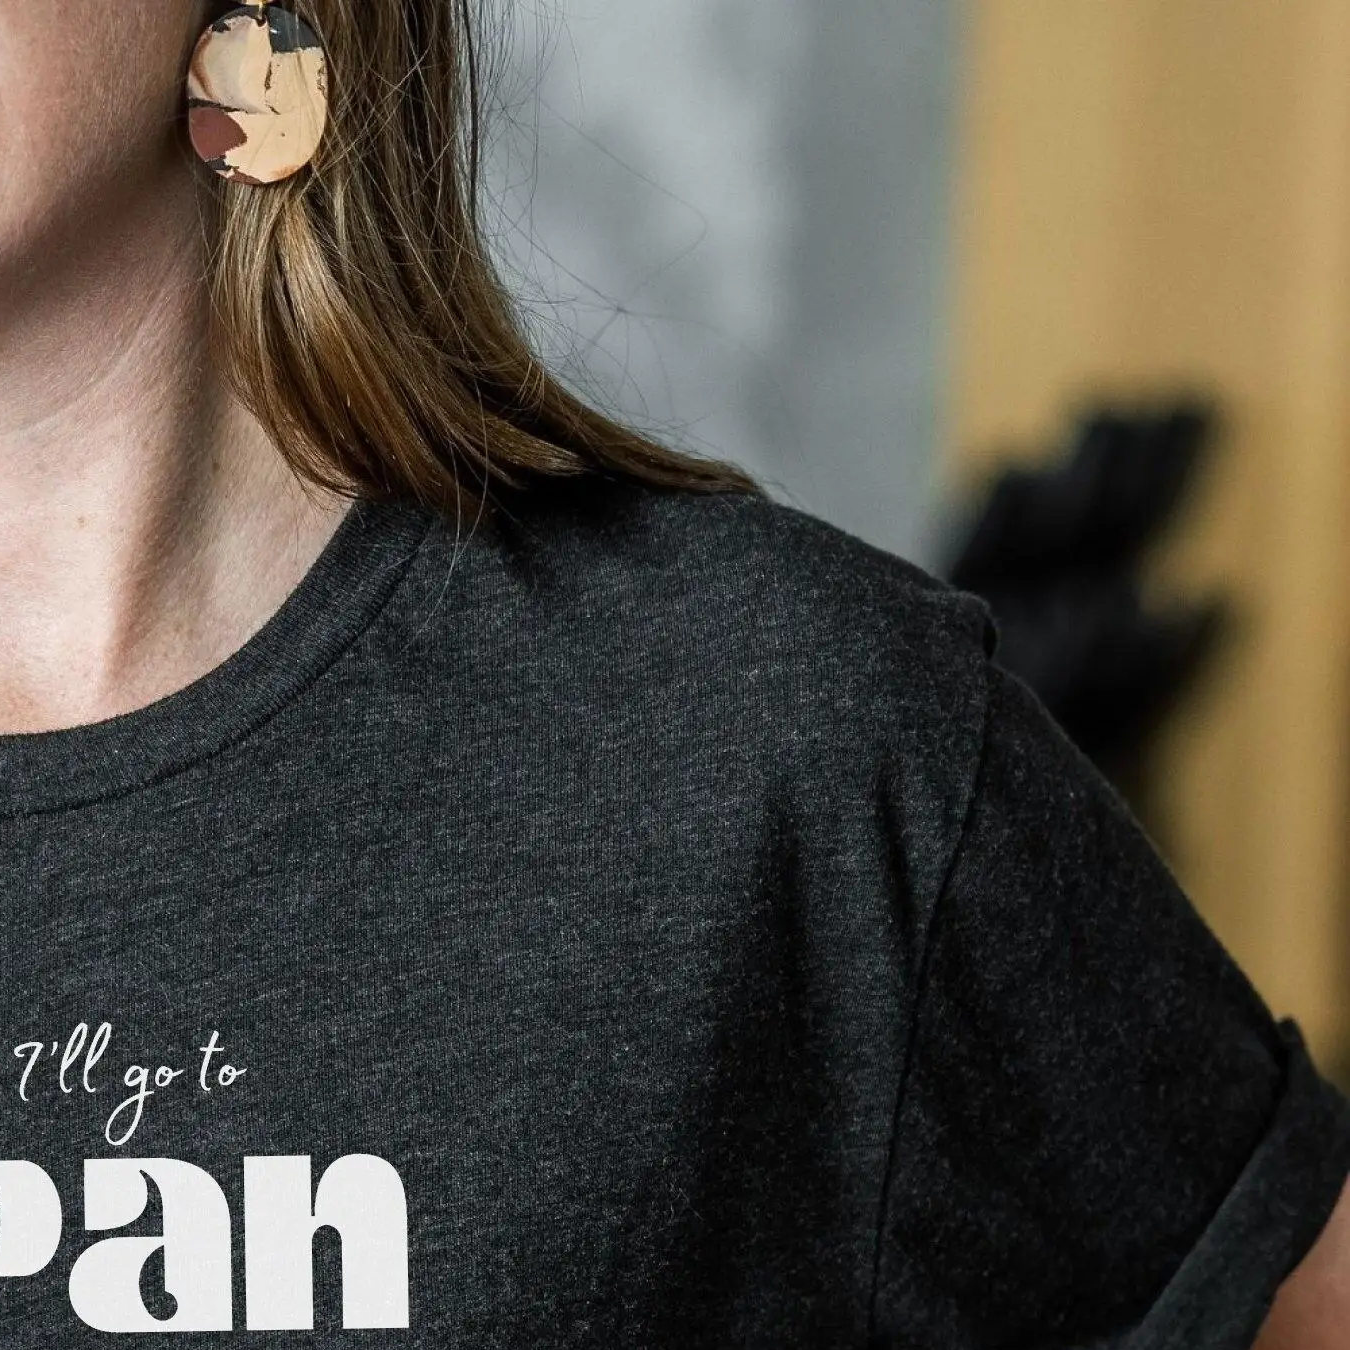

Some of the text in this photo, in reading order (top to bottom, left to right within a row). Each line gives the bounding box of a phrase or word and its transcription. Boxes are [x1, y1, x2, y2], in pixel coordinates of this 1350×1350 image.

[14, 1022, 112, 1102] I'll
[105, 1066, 184, 1146] go
[200, 1031, 247, 1092] to
